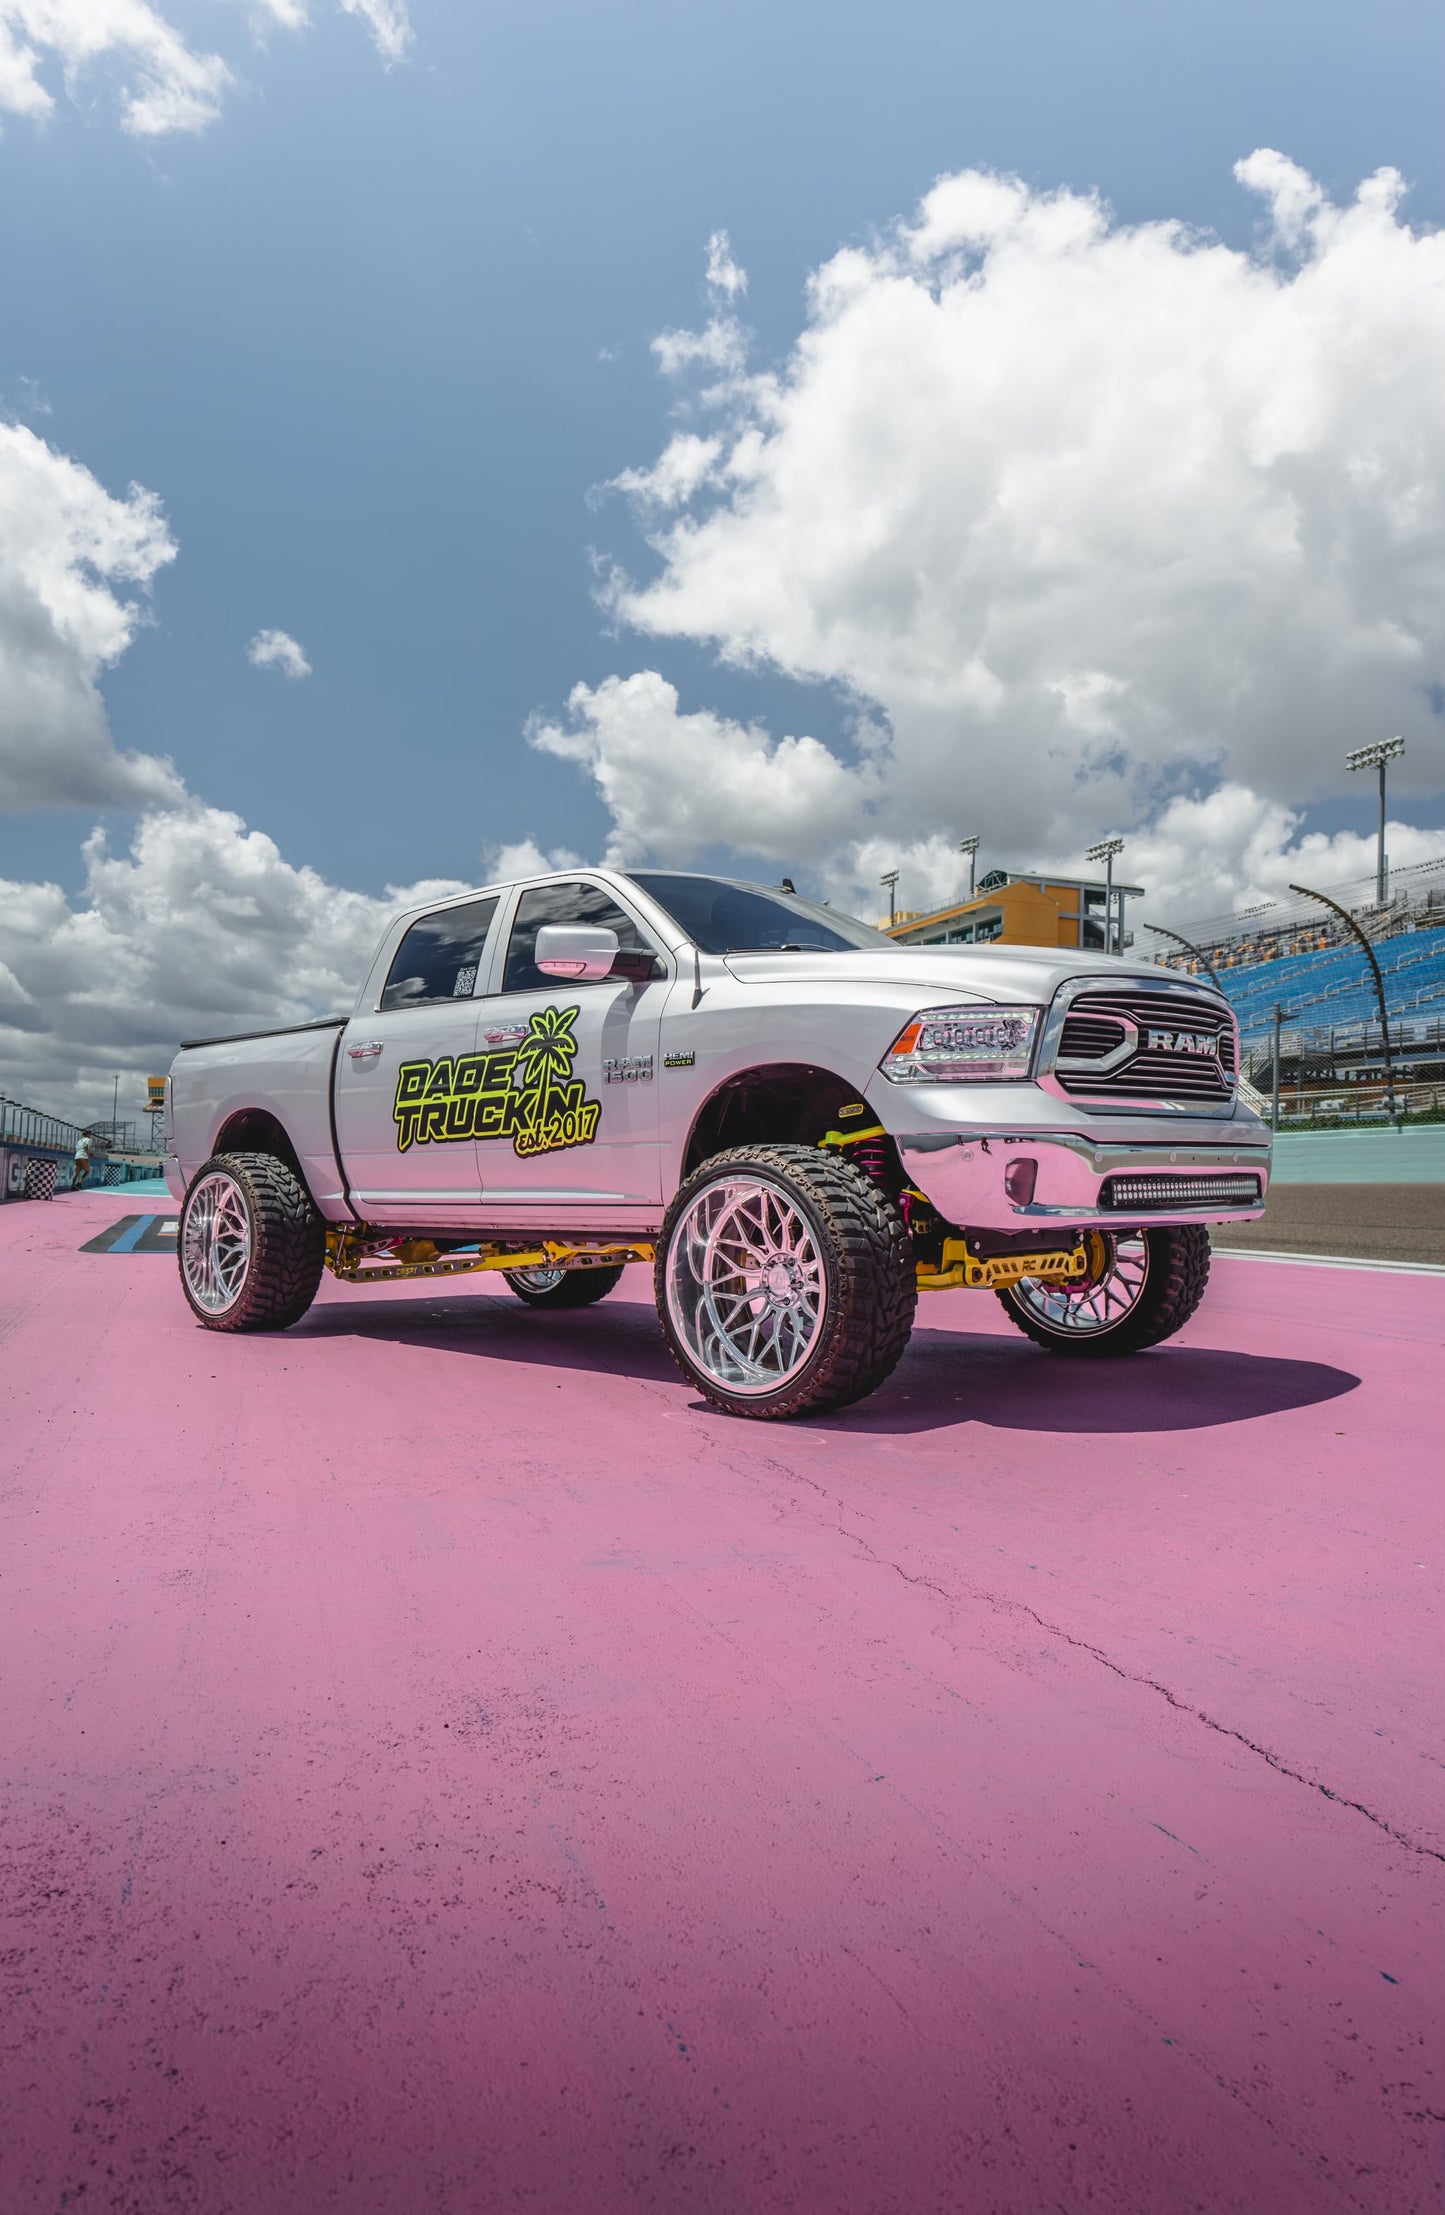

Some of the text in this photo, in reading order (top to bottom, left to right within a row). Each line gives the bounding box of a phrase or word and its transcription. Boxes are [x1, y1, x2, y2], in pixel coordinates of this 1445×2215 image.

[1147, 1029, 1217, 1055] RAM
[603, 1055, 653, 1070] RAM
[663, 1051, 696, 1060] HEMI
[664, 1059, 693, 1067] POWER
[398, 1053, 517, 1102] DADE
[604, 1069, 653, 1083] 1500
[550, 1105, 598, 1146] 2017
